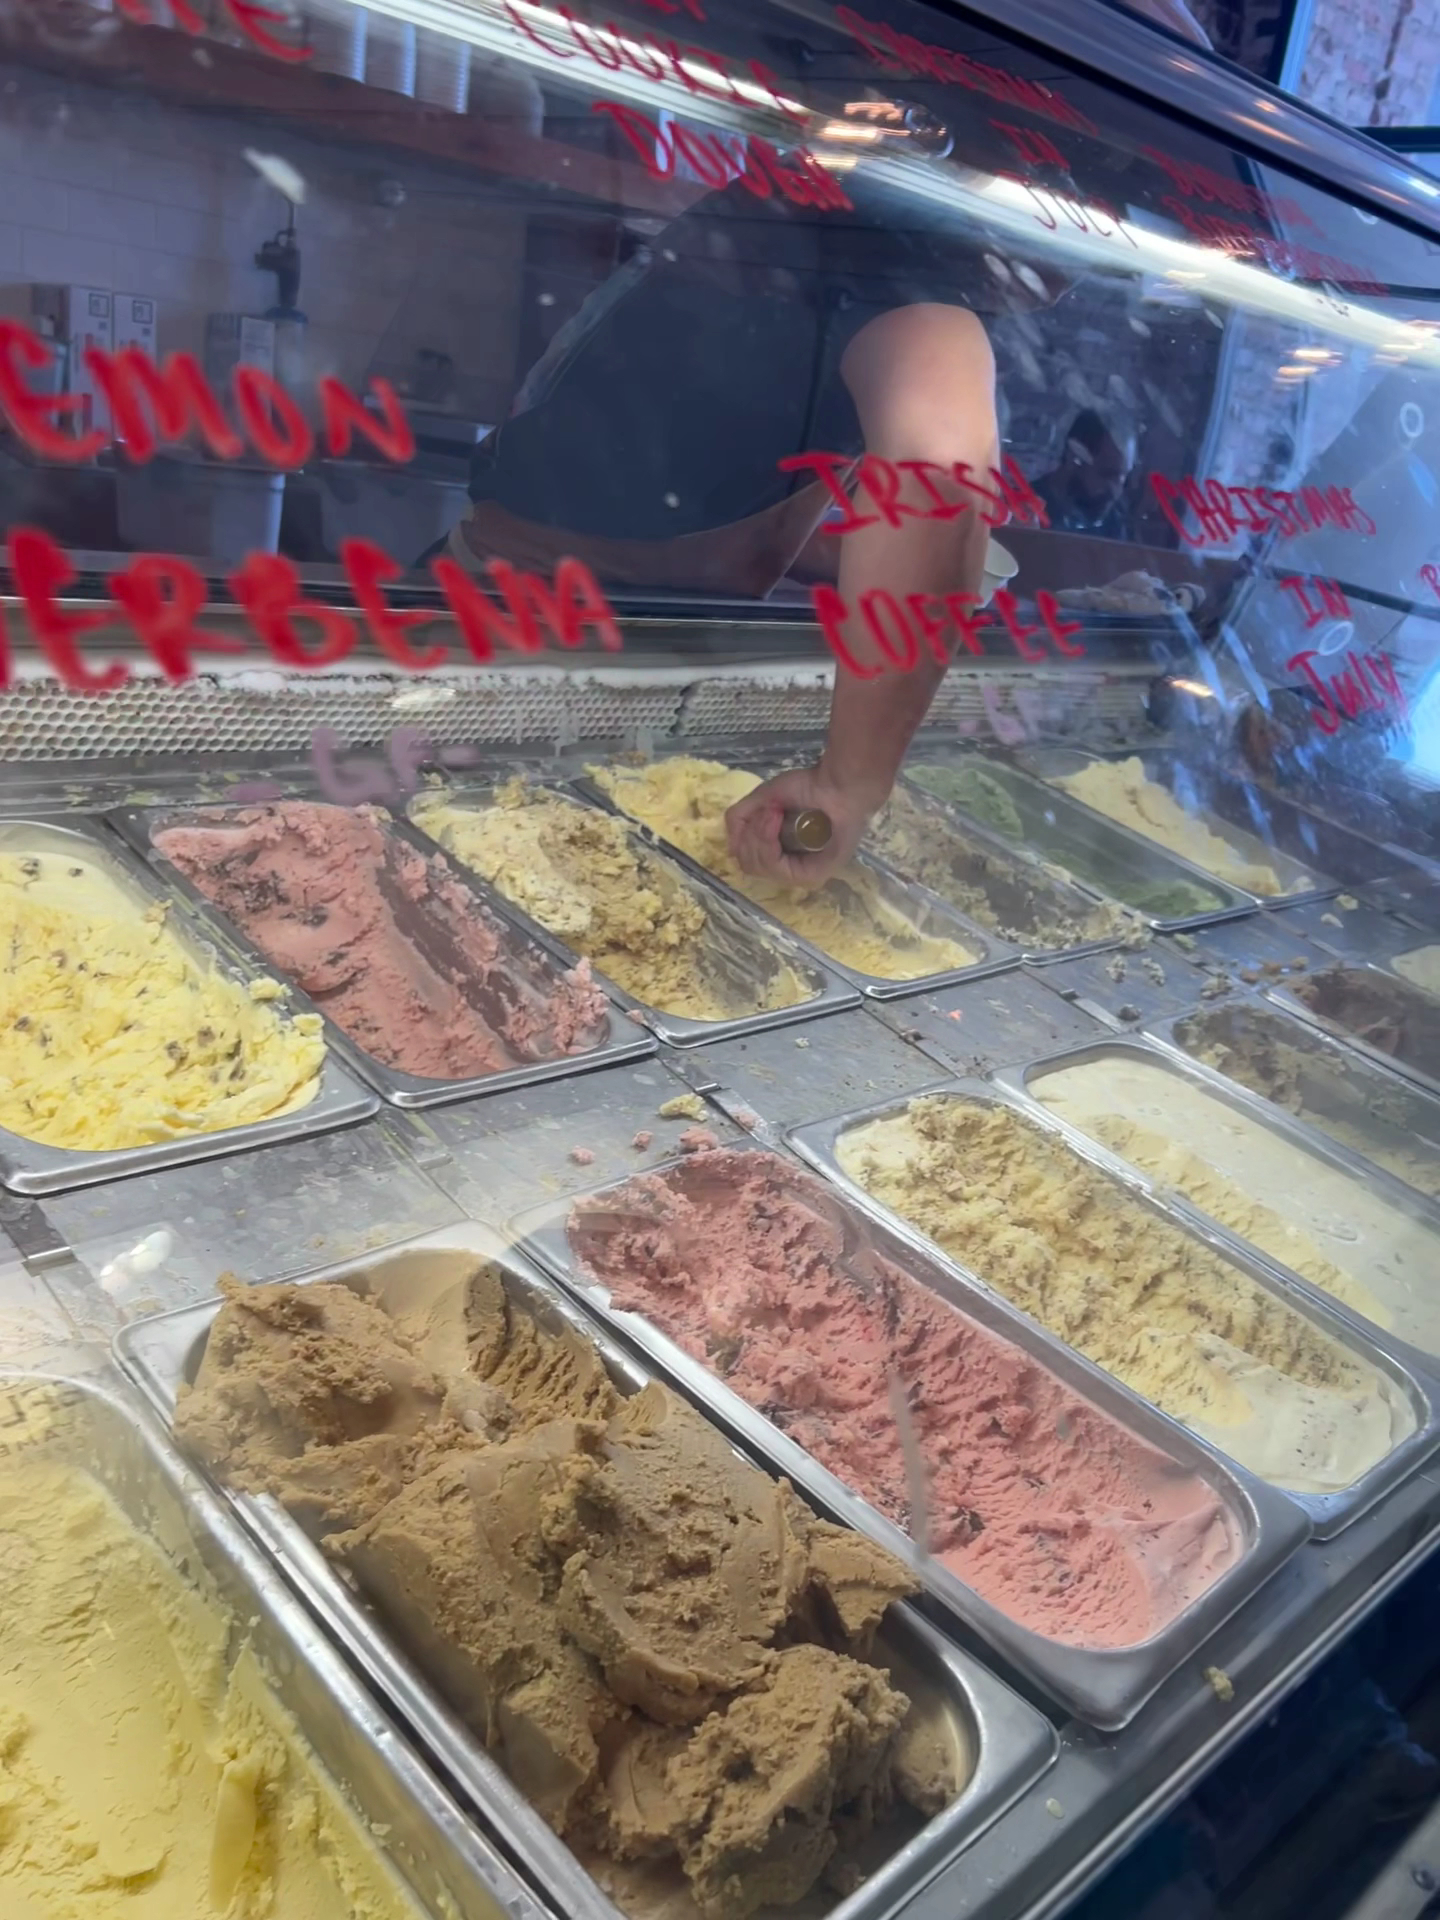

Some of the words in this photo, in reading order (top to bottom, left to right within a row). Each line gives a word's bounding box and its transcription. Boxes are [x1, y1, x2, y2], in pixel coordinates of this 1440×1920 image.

[592, 99, 855, 212] DOUGH
[779, 453, 1052, 535] IRISH
[1150, 470, 1377, 547] CHRISTMAS
[0, 525, 623, 697] ERBENA
[812, 584, 1086, 681] COFFEE
[1280, 576, 1351, 628] IN
